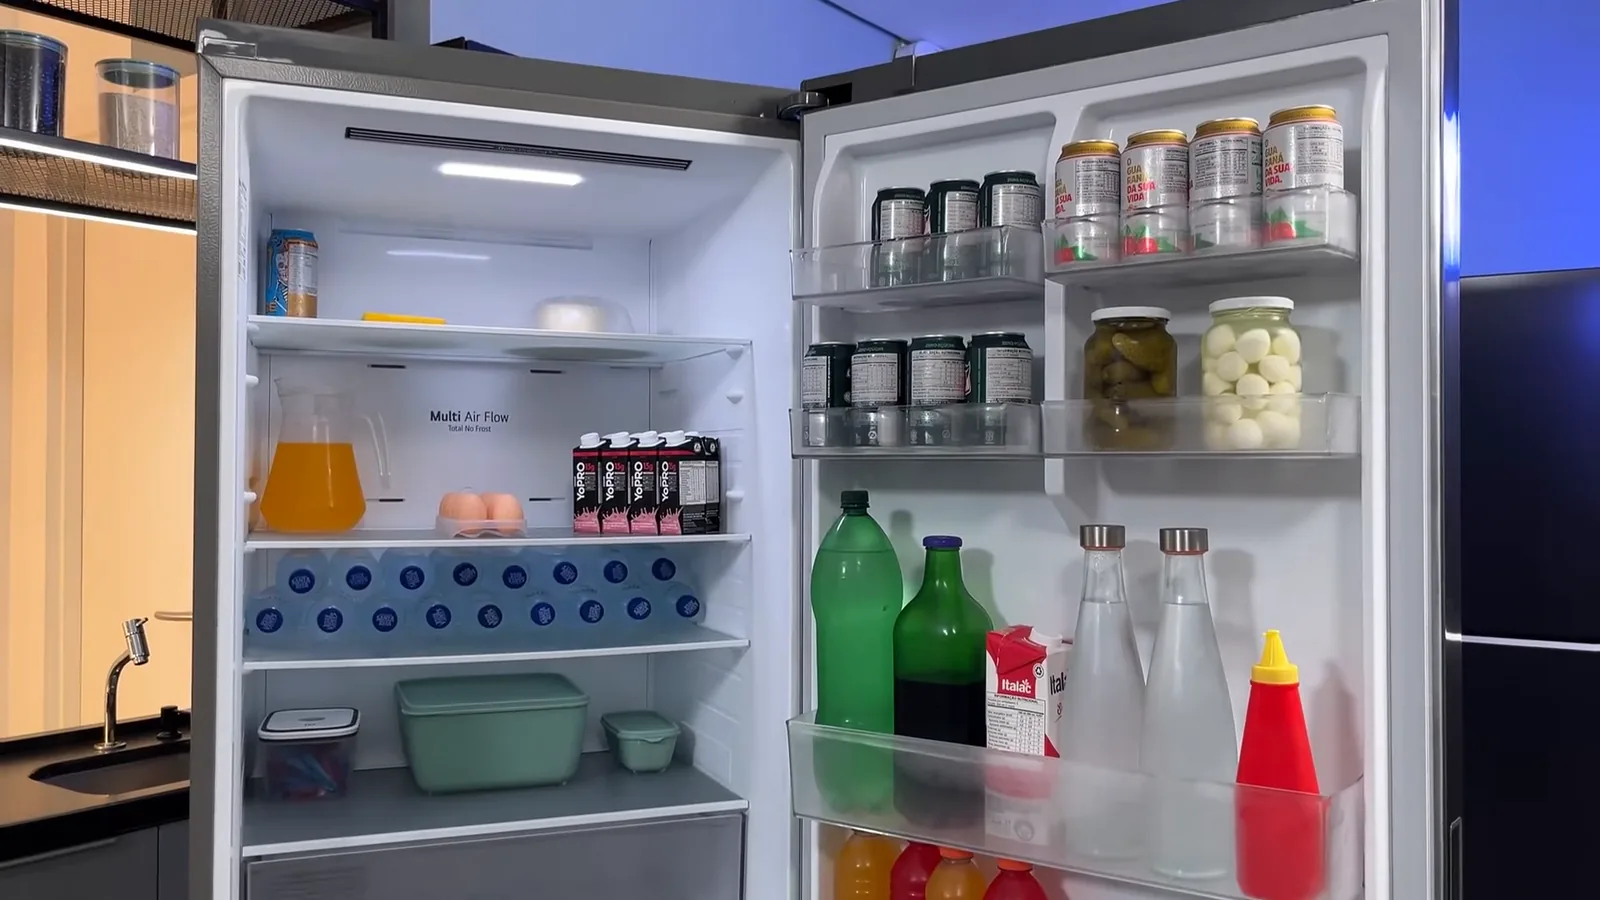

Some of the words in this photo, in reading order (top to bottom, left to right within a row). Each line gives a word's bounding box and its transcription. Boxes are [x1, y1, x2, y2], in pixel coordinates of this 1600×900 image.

[1127, 165, 1142, 175] GUA
[1274, 163, 1291, 174] SUA
[1127, 184, 1137, 195] DA
[1138, 181, 1156, 192] SUA
[430, 410, 461, 422] Multi
[464, 411, 481, 422] Air
[484, 411, 510, 423] Flow
[448, 424, 464, 432] Total
[475, 425, 492, 433] Frost
[576, 462, 585, 501] YoPRO
[605, 461, 615, 501] YoPRO
[634, 461, 643, 502] YoPRO
[661, 461, 669, 502] YoPRO
[1001, 678, 1032, 694] Italac
